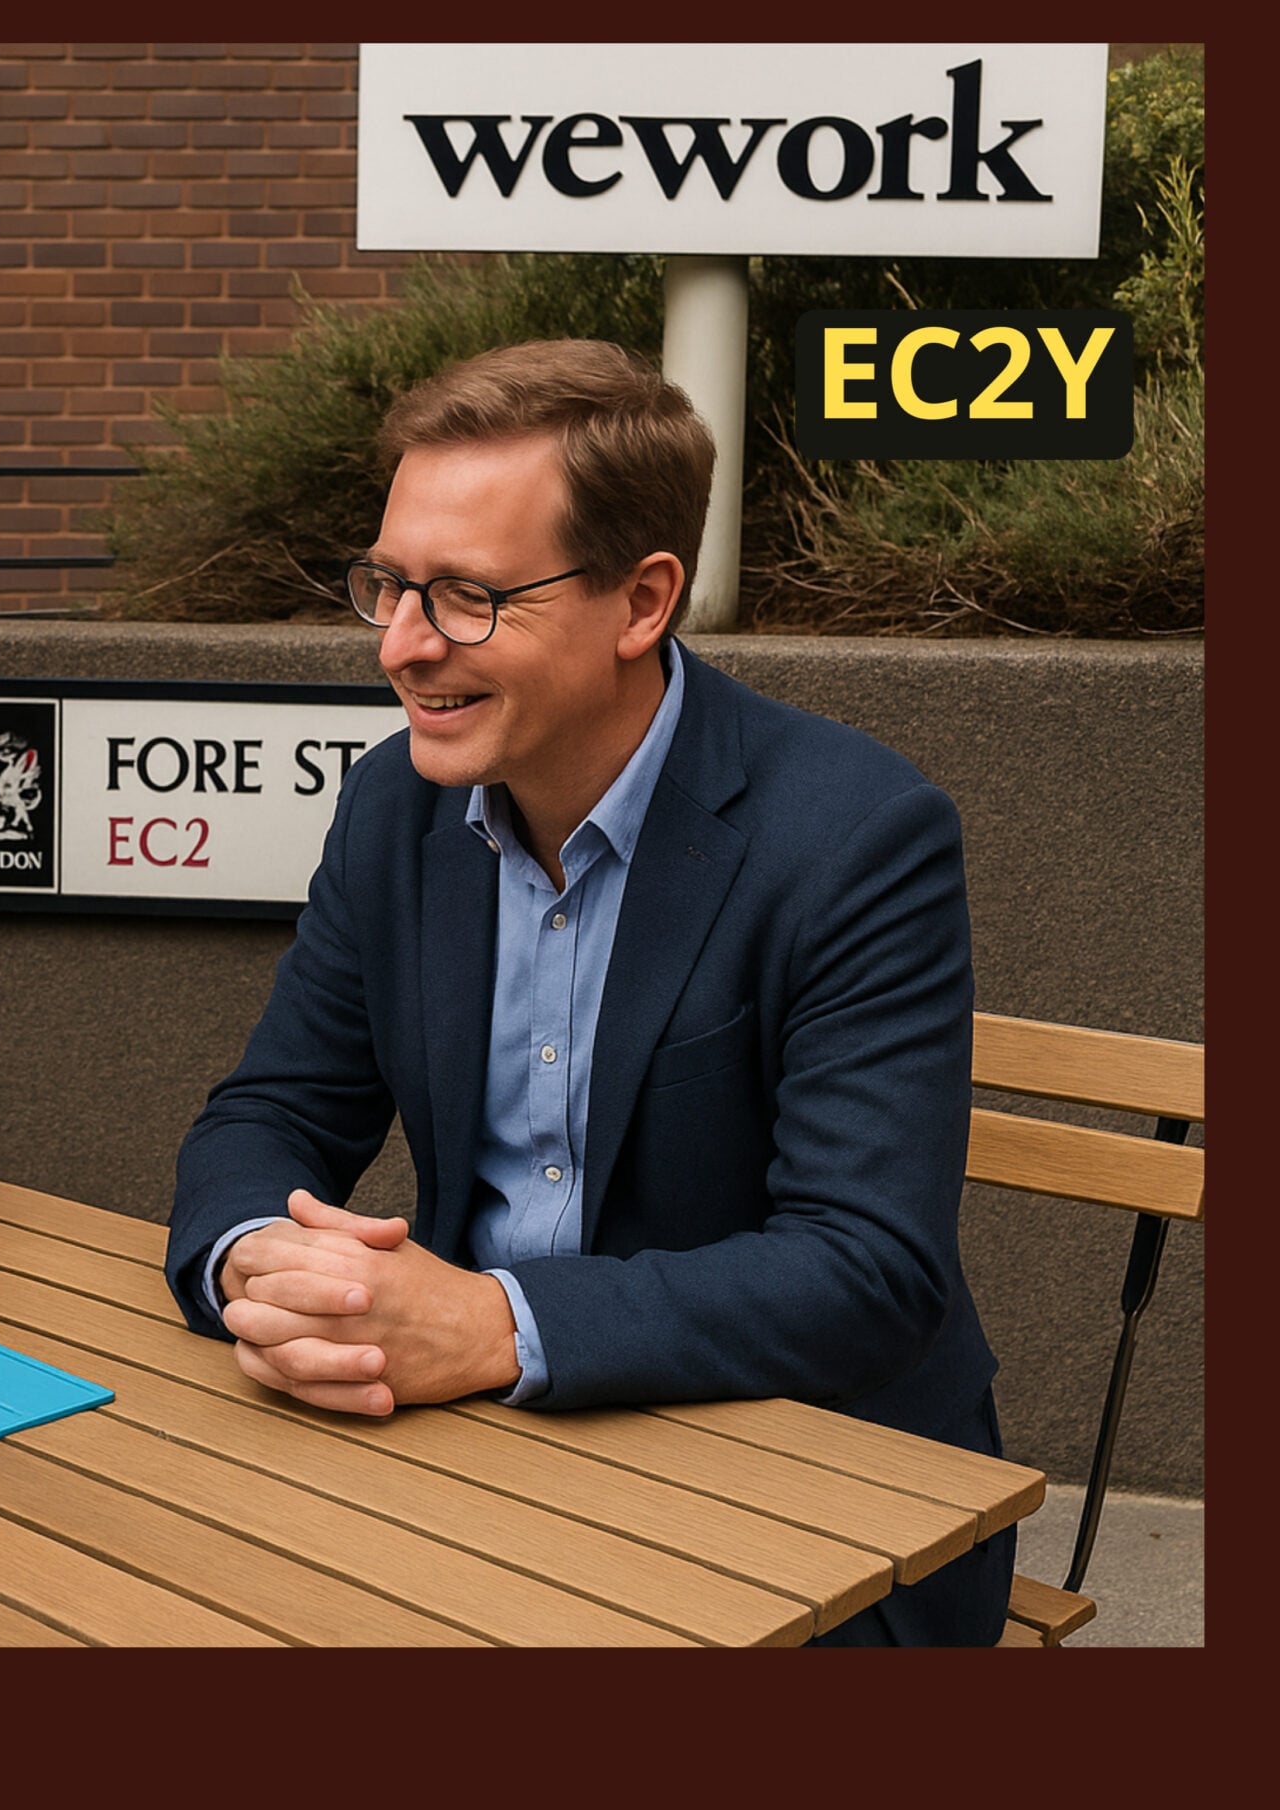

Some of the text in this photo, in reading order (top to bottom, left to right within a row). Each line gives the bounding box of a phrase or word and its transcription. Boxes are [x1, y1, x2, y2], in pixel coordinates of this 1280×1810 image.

[403, 58, 1053, 204] wework
[106, 737, 263, 793] FORE
[107, 817, 210, 868] EC2
